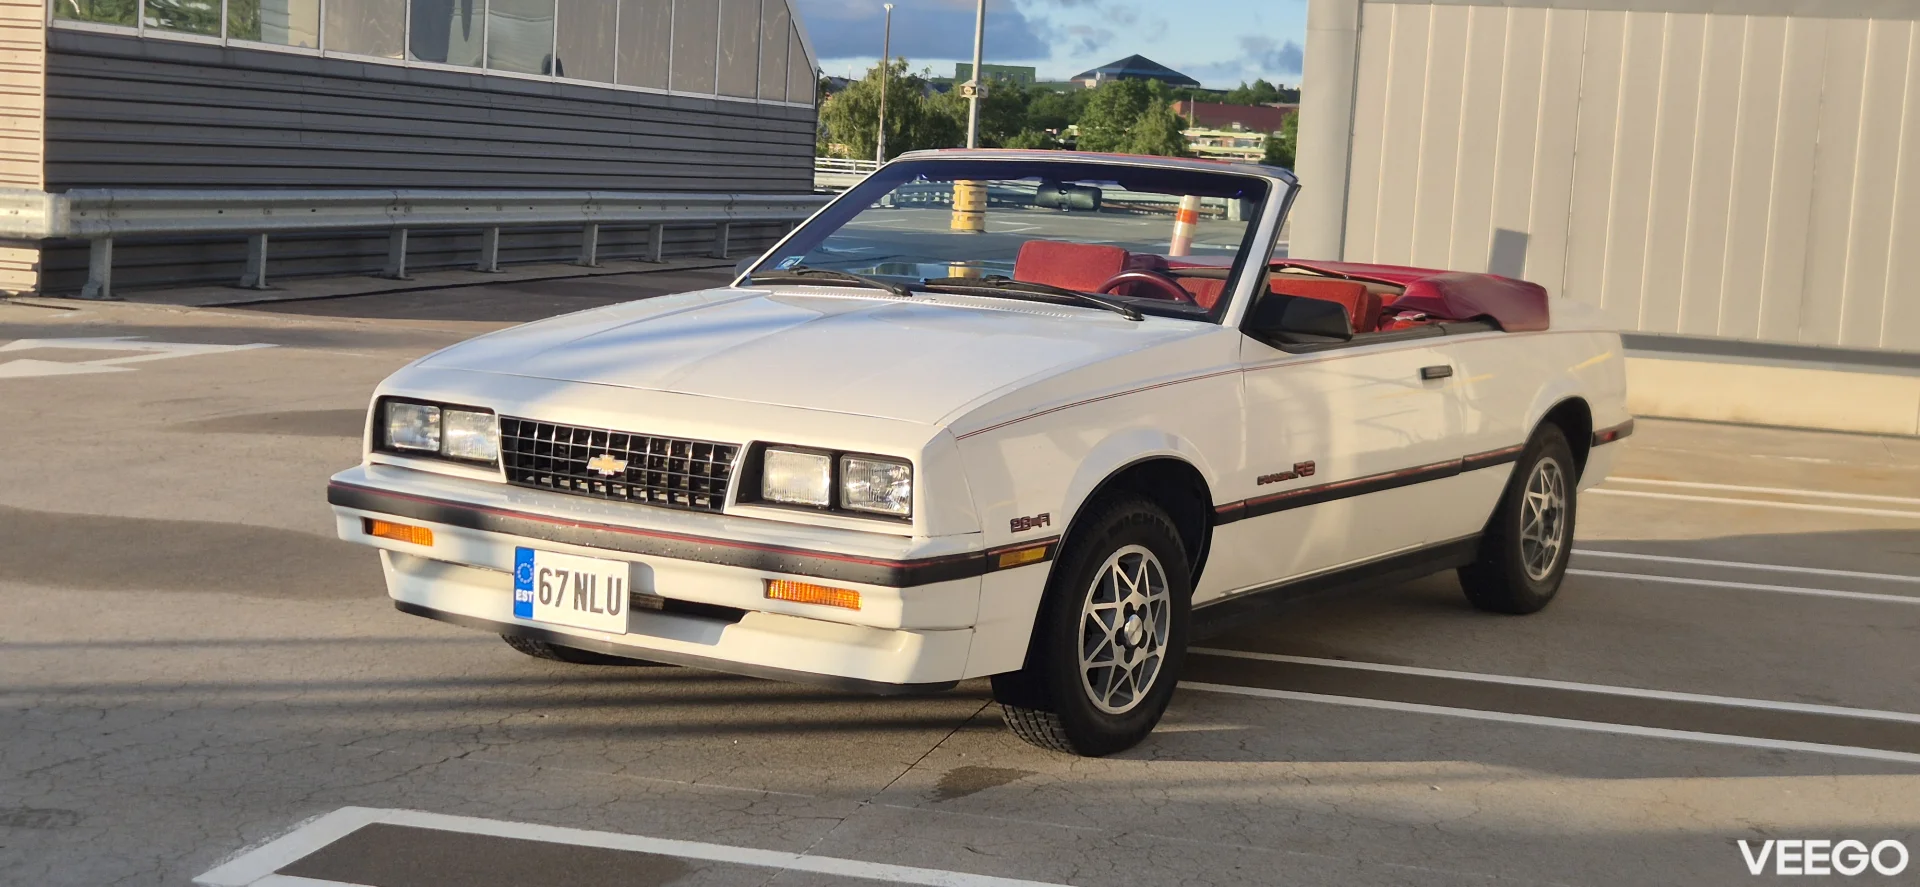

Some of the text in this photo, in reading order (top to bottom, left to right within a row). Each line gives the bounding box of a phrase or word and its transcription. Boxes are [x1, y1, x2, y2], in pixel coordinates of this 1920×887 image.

[515, 589, 534, 603] EST
[538, 567, 622, 616] 67 NLU
